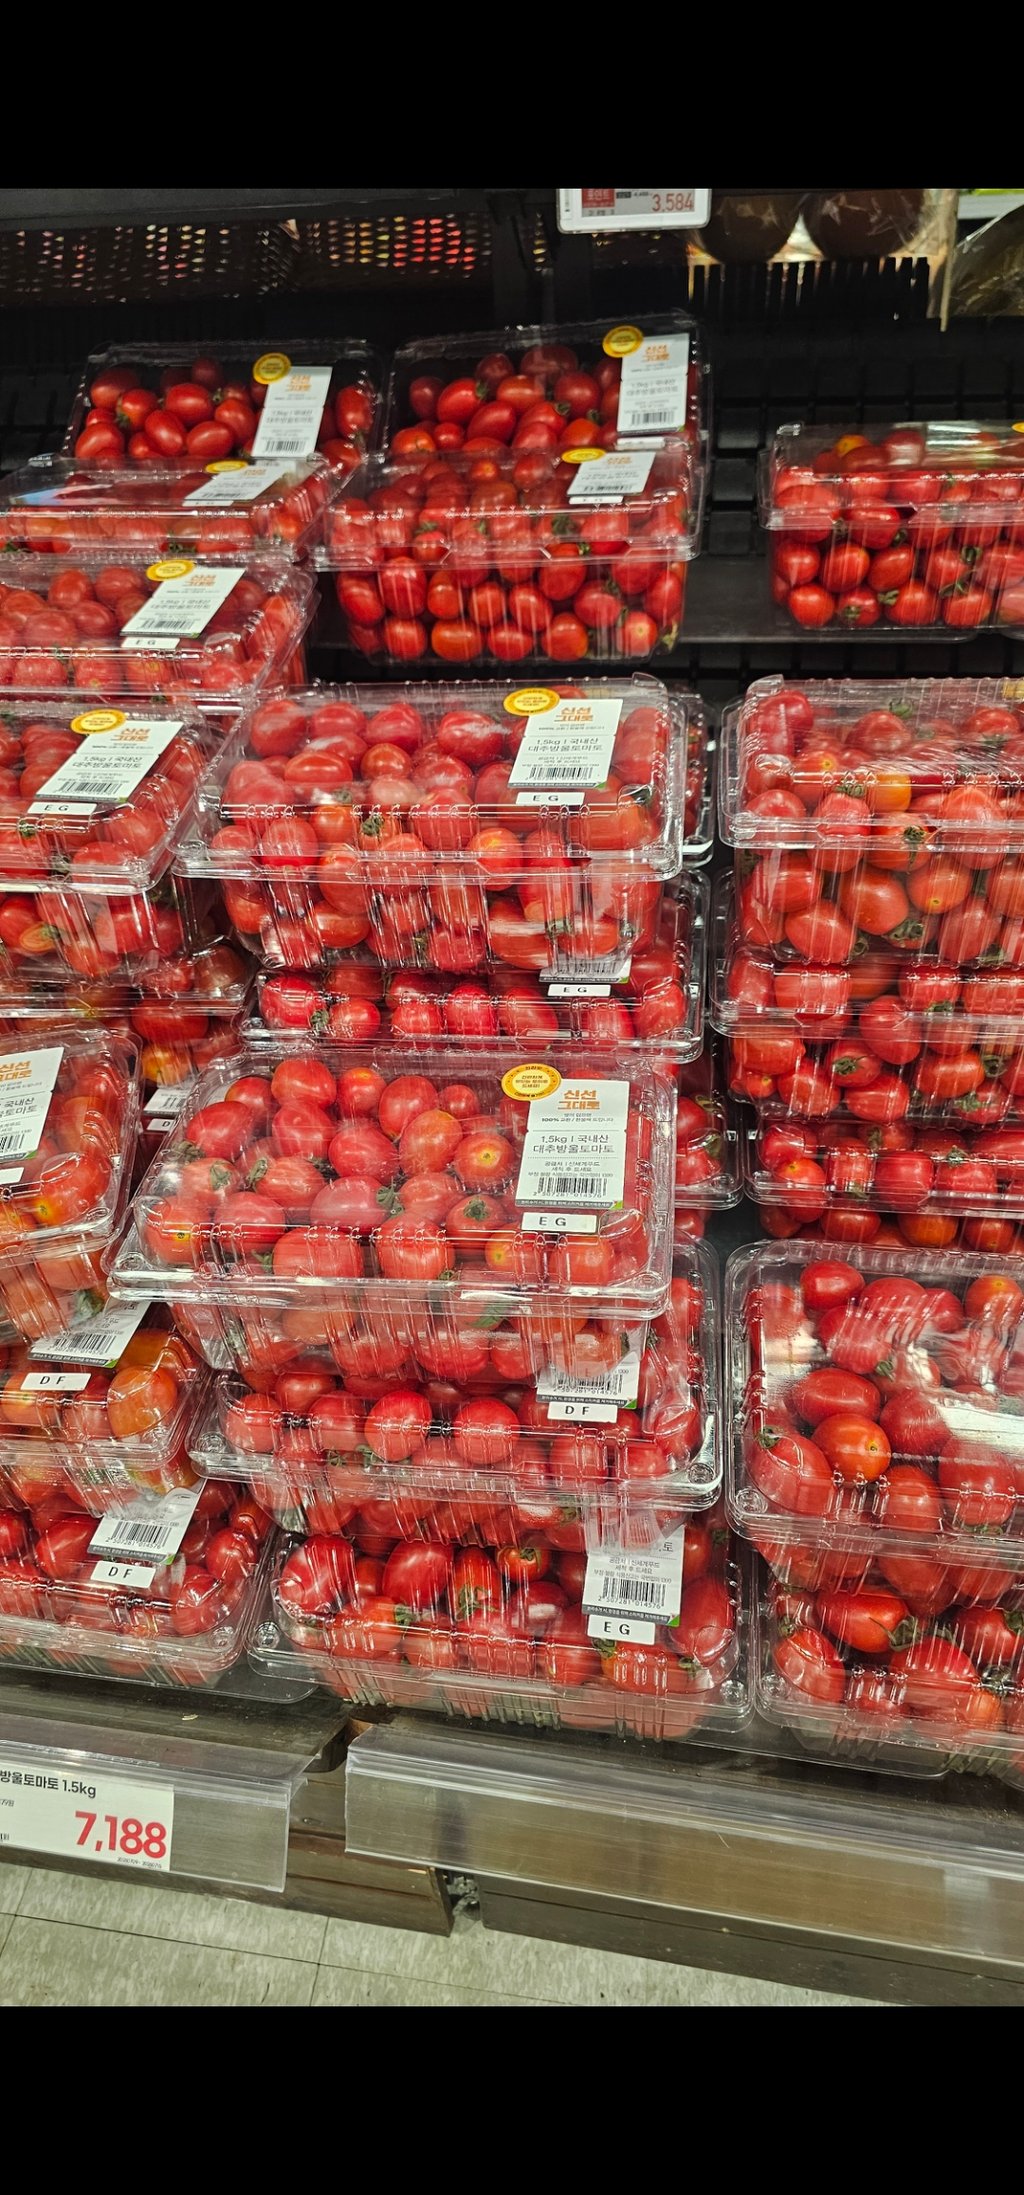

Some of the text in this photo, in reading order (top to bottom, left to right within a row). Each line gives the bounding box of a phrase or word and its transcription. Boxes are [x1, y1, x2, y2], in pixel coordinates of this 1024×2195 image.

[564, 1090, 597, 1100] 신선
[558, 1101, 600, 1110] 그대로
[541, 1136, 567, 1144] 1.5kg
[578, 1134, 609, 1143] 국내산
[533, 1144, 615, 1154] 대추방울토마토
[539, 1217, 566, 1226] E G
[40, 1376, 65, 1384] D F
[565, 1406, 590, 1415] D F
[632, 1559, 660, 1568] 신세계푸드
[108, 1567, 133, 1578] D F
[635, 1601, 661, 1609] 014576
[603, 1622, 630, 1635] E G
[0, 1770, 97, 1799] 방울토마토 1.5kg
[75, 1810, 167, 1859] 7,188
